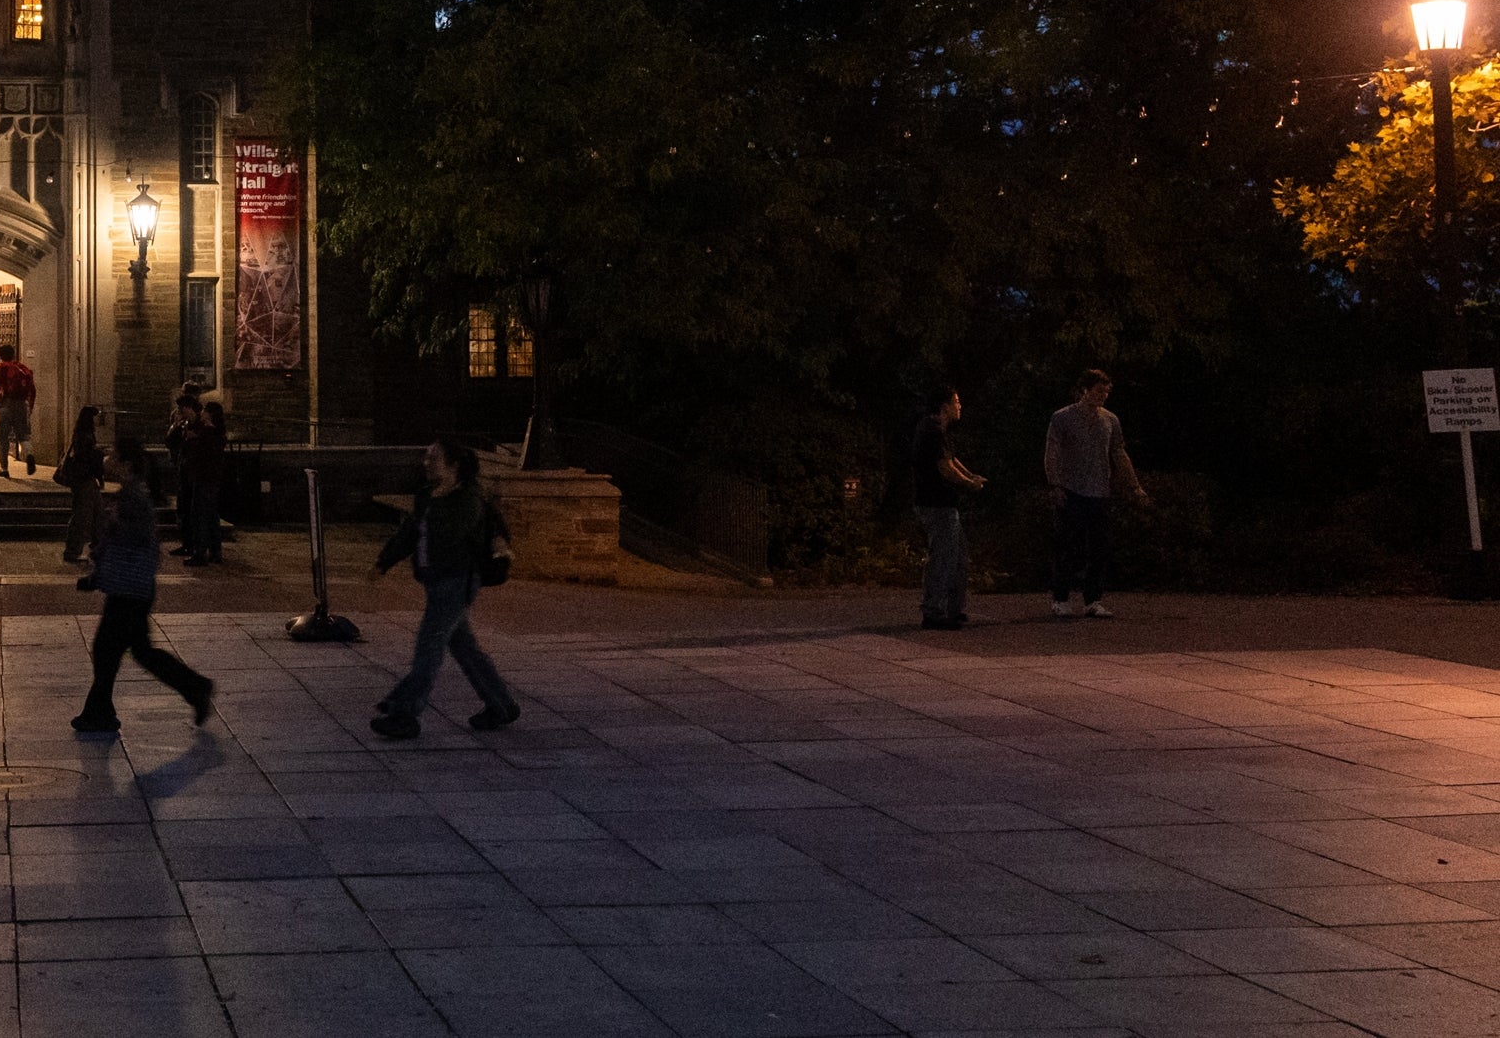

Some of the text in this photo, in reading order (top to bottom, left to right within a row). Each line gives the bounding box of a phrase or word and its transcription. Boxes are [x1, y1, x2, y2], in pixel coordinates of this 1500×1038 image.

[235, 144, 291, 158] Willa
[235, 176, 266, 189] Hall
[1451, 376, 1466, 384] No
[1433, 397, 1473, 405] Parking
[1429, 405, 1497, 415] Accessibility
[1445, 418, 1482, 426] Ramps
